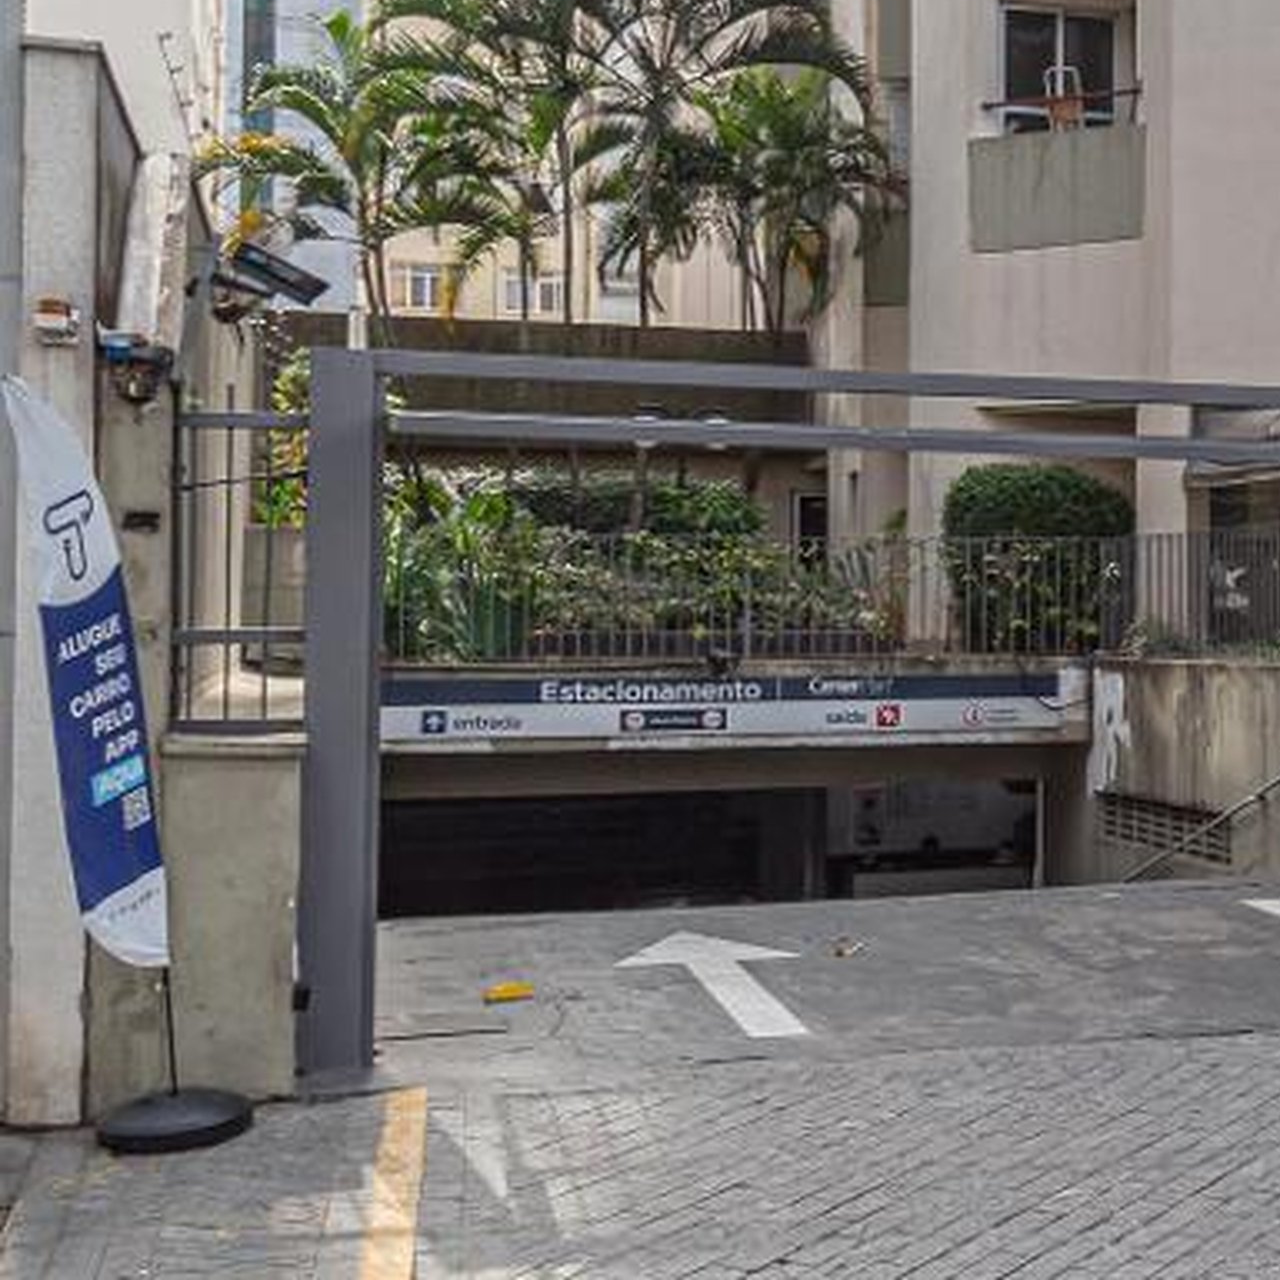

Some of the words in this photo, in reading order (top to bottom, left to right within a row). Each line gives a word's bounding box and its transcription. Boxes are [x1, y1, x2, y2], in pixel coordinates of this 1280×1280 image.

[70, 672, 131, 719] CARRO
[540, 679, 762, 703] Estacionamento
[92, 701, 135, 738] PELO
[452, 714, 522, 732] entrada
[105, 729, 139, 764] APP
